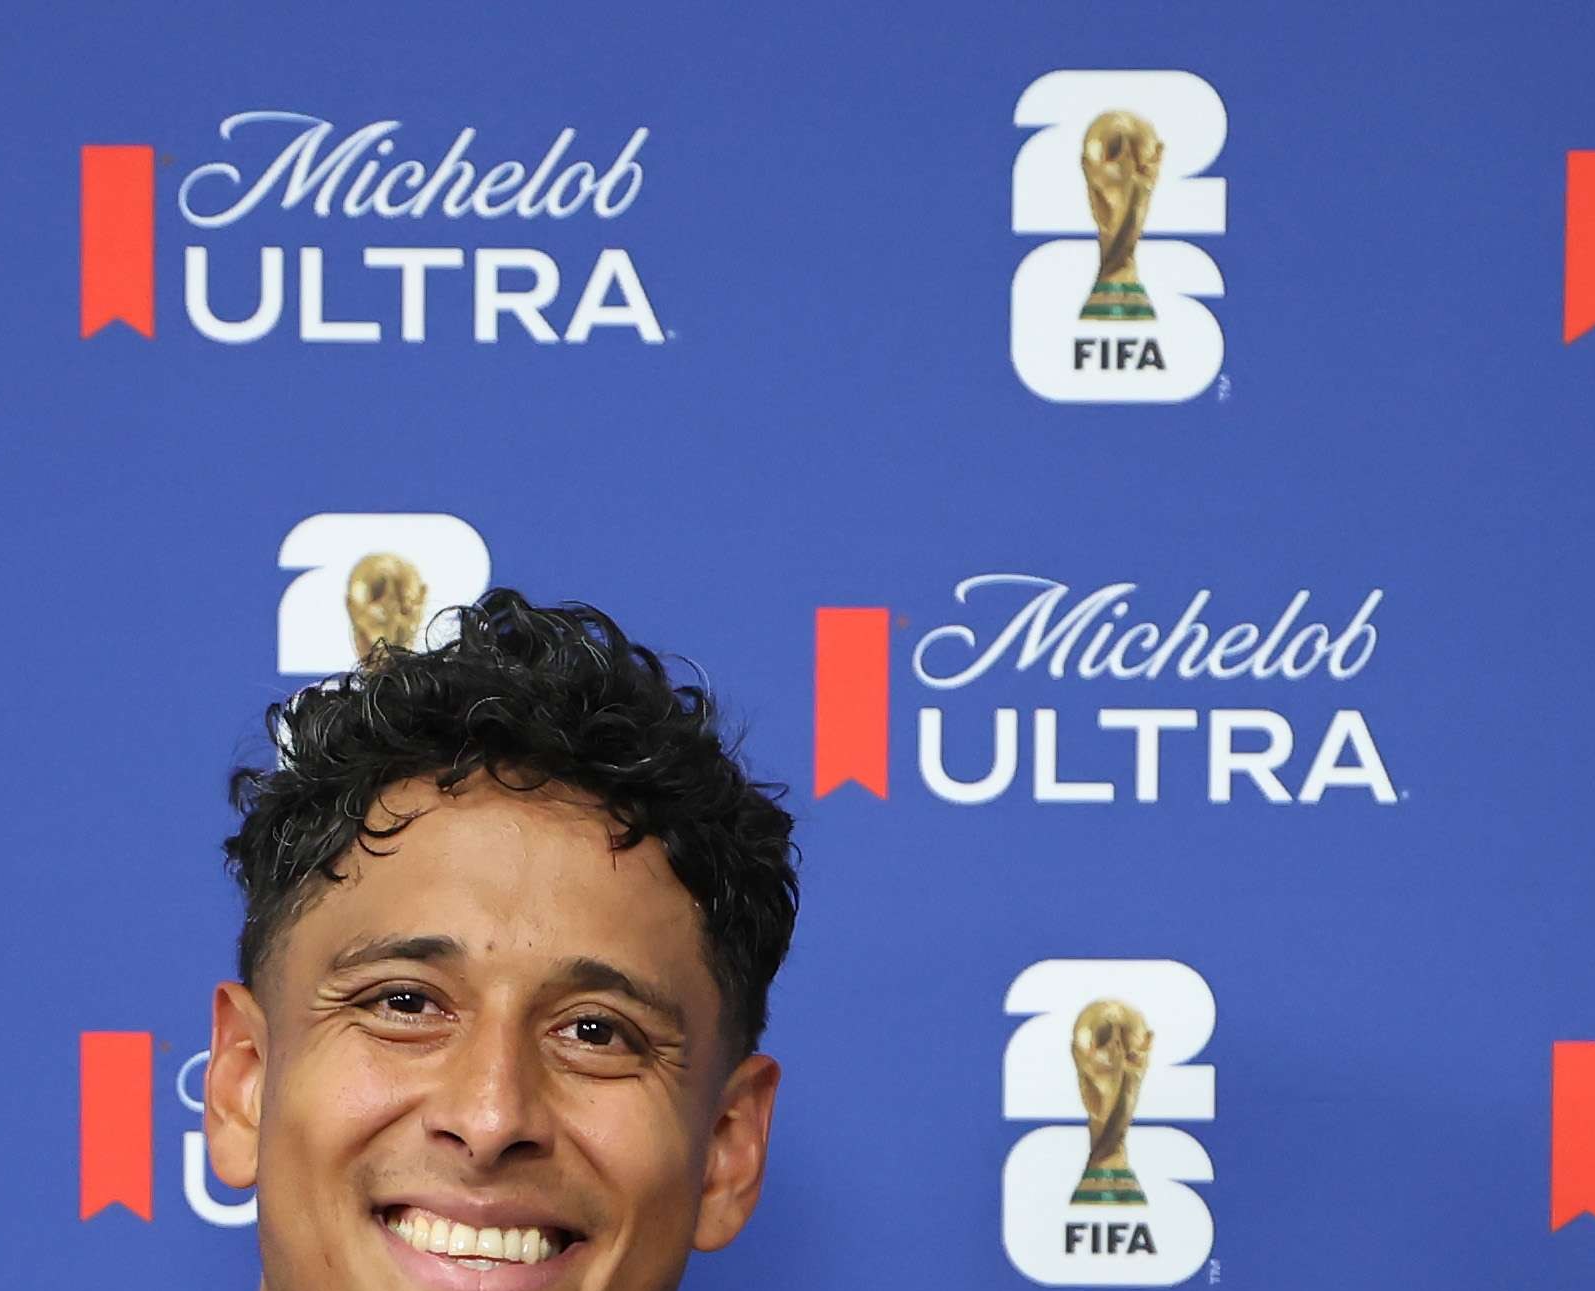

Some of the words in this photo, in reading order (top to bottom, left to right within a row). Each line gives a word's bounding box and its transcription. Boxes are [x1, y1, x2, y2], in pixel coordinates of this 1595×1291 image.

[179, 111, 649, 227] Michelob
[185, 246, 665, 344] ULTRA
[1075, 340, 1164, 369] FIFA
[912, 574, 1383, 688] Michelob
[919, 708, 1397, 804] ULTRA
[1066, 1224, 1156, 1254] FIFA
